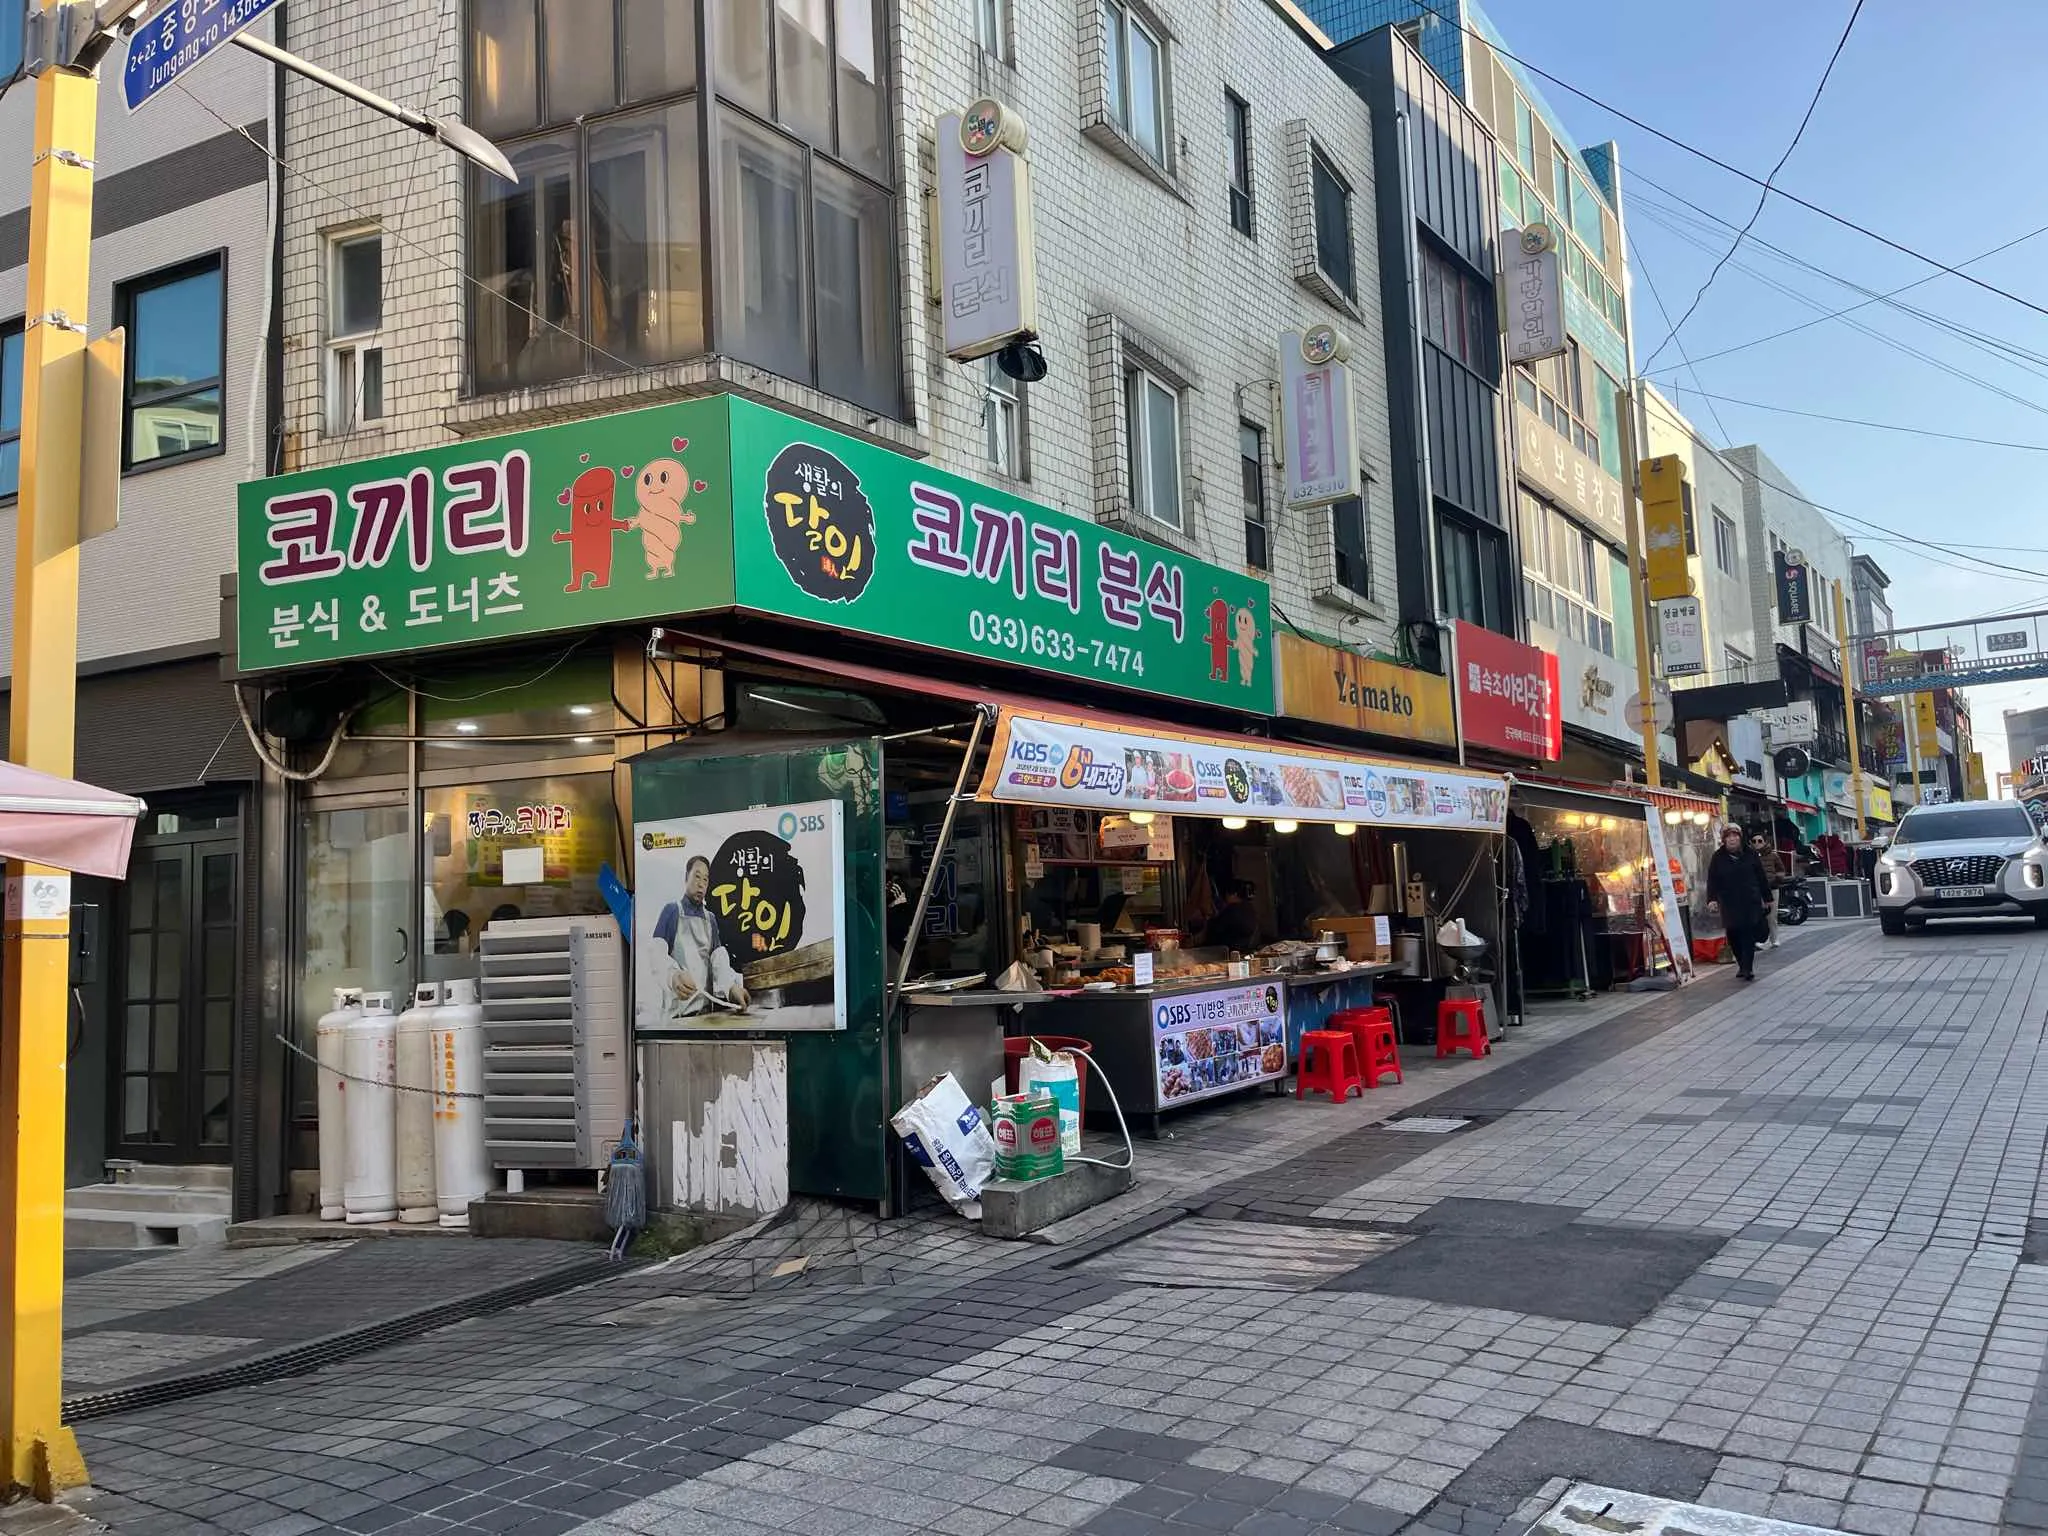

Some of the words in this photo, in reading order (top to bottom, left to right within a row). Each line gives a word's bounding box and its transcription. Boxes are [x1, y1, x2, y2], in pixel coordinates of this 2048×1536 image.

[150, 24, 218, 89] Jungang-ro
[794, 463, 843, 501] 생활의
[1554, 443, 1623, 526] 보물창고
[259, 448, 532, 586] 코끼리
[773, 492, 862, 580] 달인
[908, 481, 1081, 614] 코끼리
[1096, 541, 1186, 645] 분식
[268, 597, 340, 649] 분식
[359, 594, 388, 634] &
[405, 572, 523, 628] 도너츠
[1788, 581, 1800, 615] SQUARE
[969, 610, 1145, 678] 033)633-7474
[1333, 669, 1414, 717] Yamako
[1011, 740, 1049, 763] KBS
[1205, 762, 1223, 778] SBS
[1081, 763, 1125, 795] 내고향
[517, 804, 572, 835] 코끼리
[799, 814, 826, 833] SBS
[729, 846, 775, 878] 생활의
[711, 877, 791, 952] 달인
